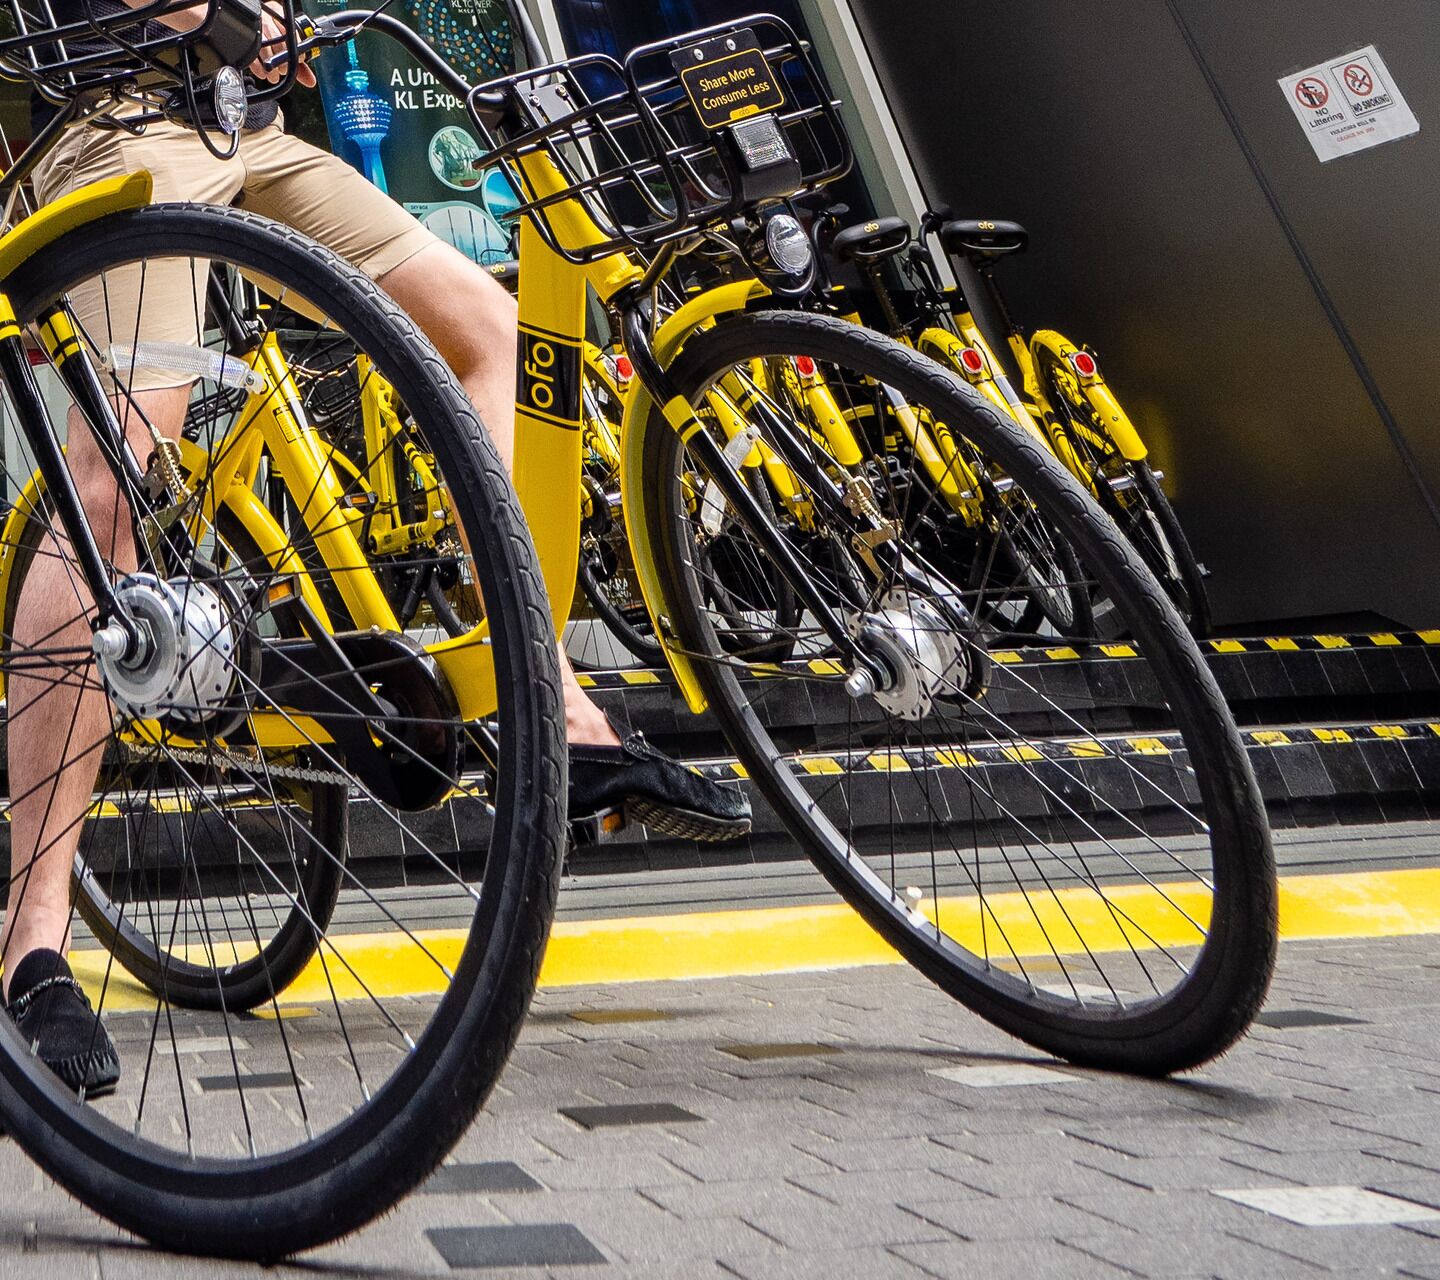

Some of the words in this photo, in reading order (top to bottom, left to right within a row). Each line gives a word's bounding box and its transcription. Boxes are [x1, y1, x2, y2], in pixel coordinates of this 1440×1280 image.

[451, 0, 462, 8] KL
[390, 68, 405, 86] A
[699, 76, 729, 93] Share
[727, 65, 756, 85] More
[395, 90, 419, 109] KL
[702, 87, 747, 111] Consume
[747, 78, 771, 97] Less
[1309, 111, 1344, 129] Littering
[1316, 107, 1329, 118] NO
[863, 222, 880, 233] ofo
[977, 220, 995, 230] ofo
[490, 263, 506, 273] ofo
[524, 341, 555, 408] ofo
